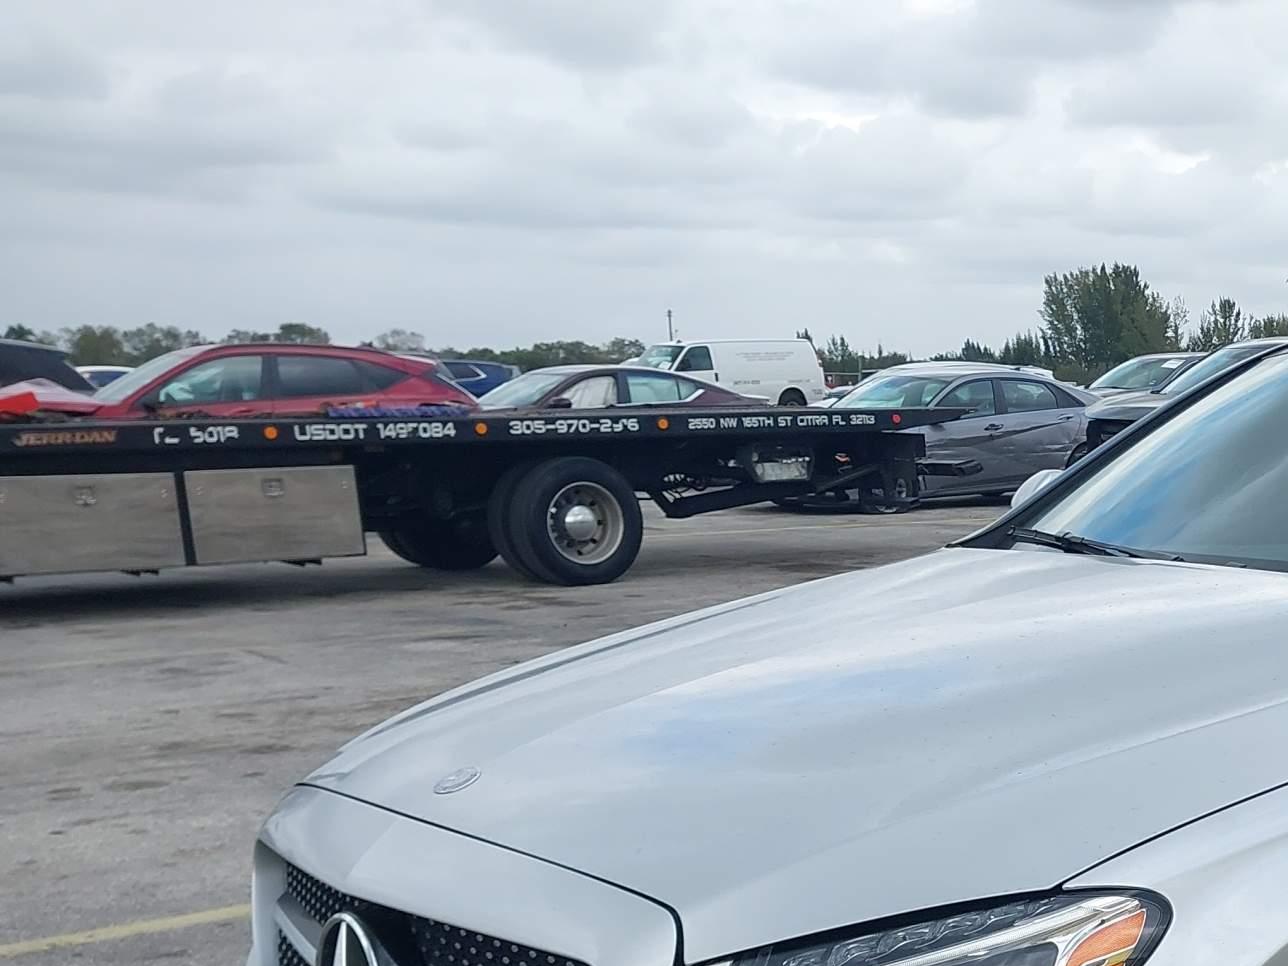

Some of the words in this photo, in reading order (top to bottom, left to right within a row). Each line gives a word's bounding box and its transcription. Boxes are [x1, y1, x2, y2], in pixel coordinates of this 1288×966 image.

[688, 418, 716, 430] 2550
[720, 417, 738, 428] NW
[778, 416, 793, 427] ST
[797, 415, 829, 426] CITRA
[832, 415, 846, 426] FL
[850, 414, 875, 425] 32113
[293, 423, 368, 441] USDOT
